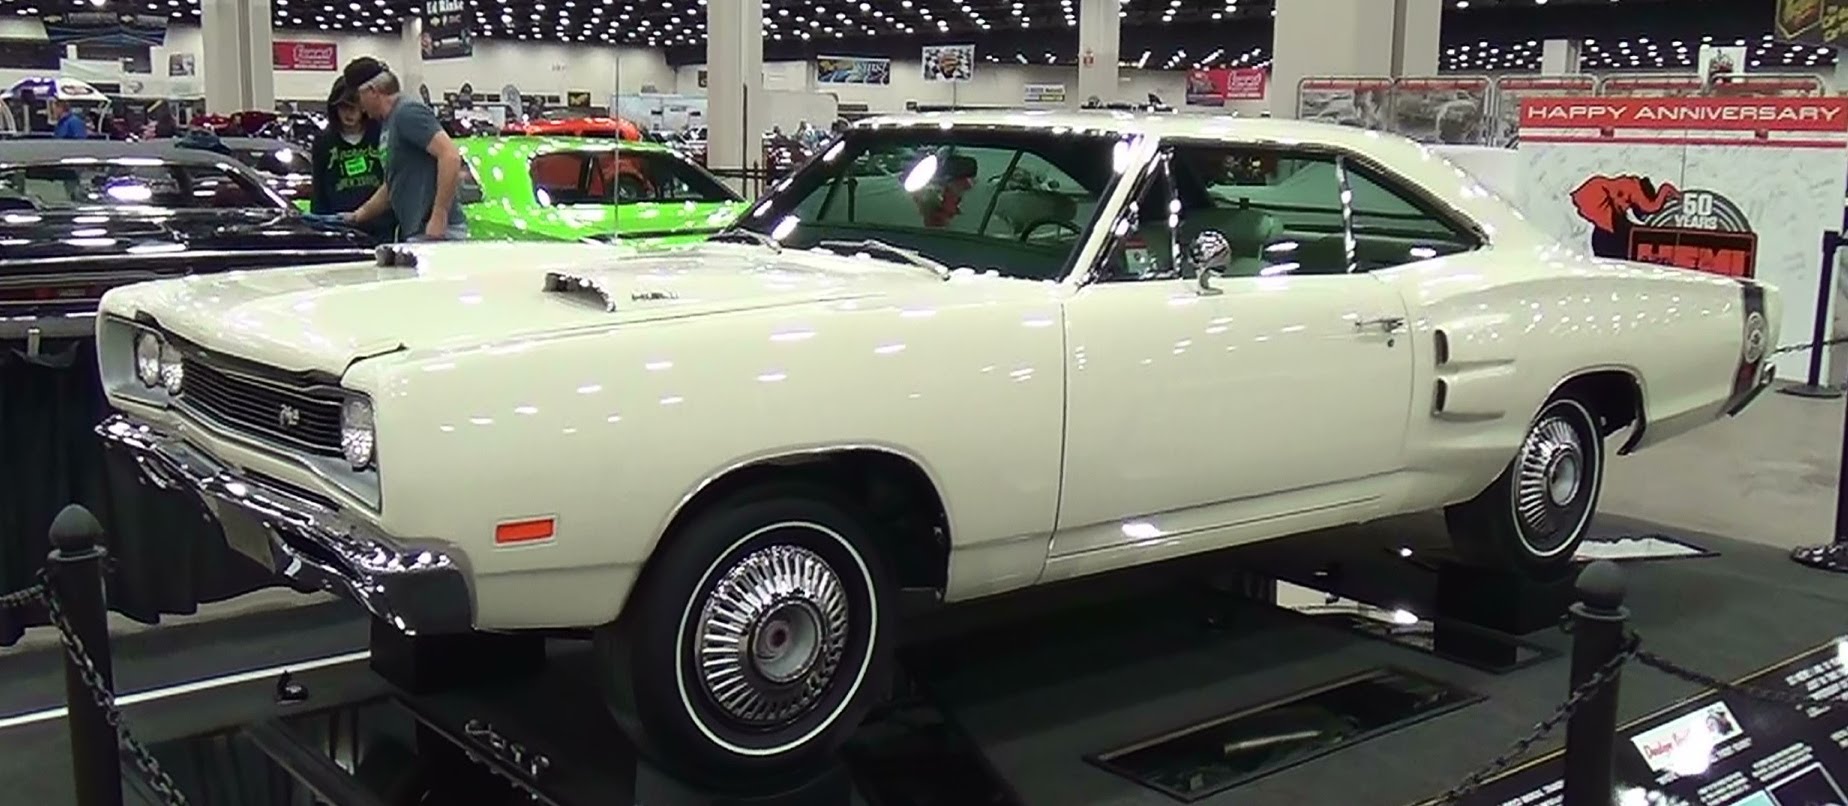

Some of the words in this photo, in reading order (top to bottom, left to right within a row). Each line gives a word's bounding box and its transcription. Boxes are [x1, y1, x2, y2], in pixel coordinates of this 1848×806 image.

[1528, 105, 1628, 120] HAPPY
[1633, 105, 1842, 122] ANNIVERSARY
[1682, 192, 1714, 216] 50
[1674, 214, 1718, 230] YEARS
[1637, 243, 1745, 276] HEMI
